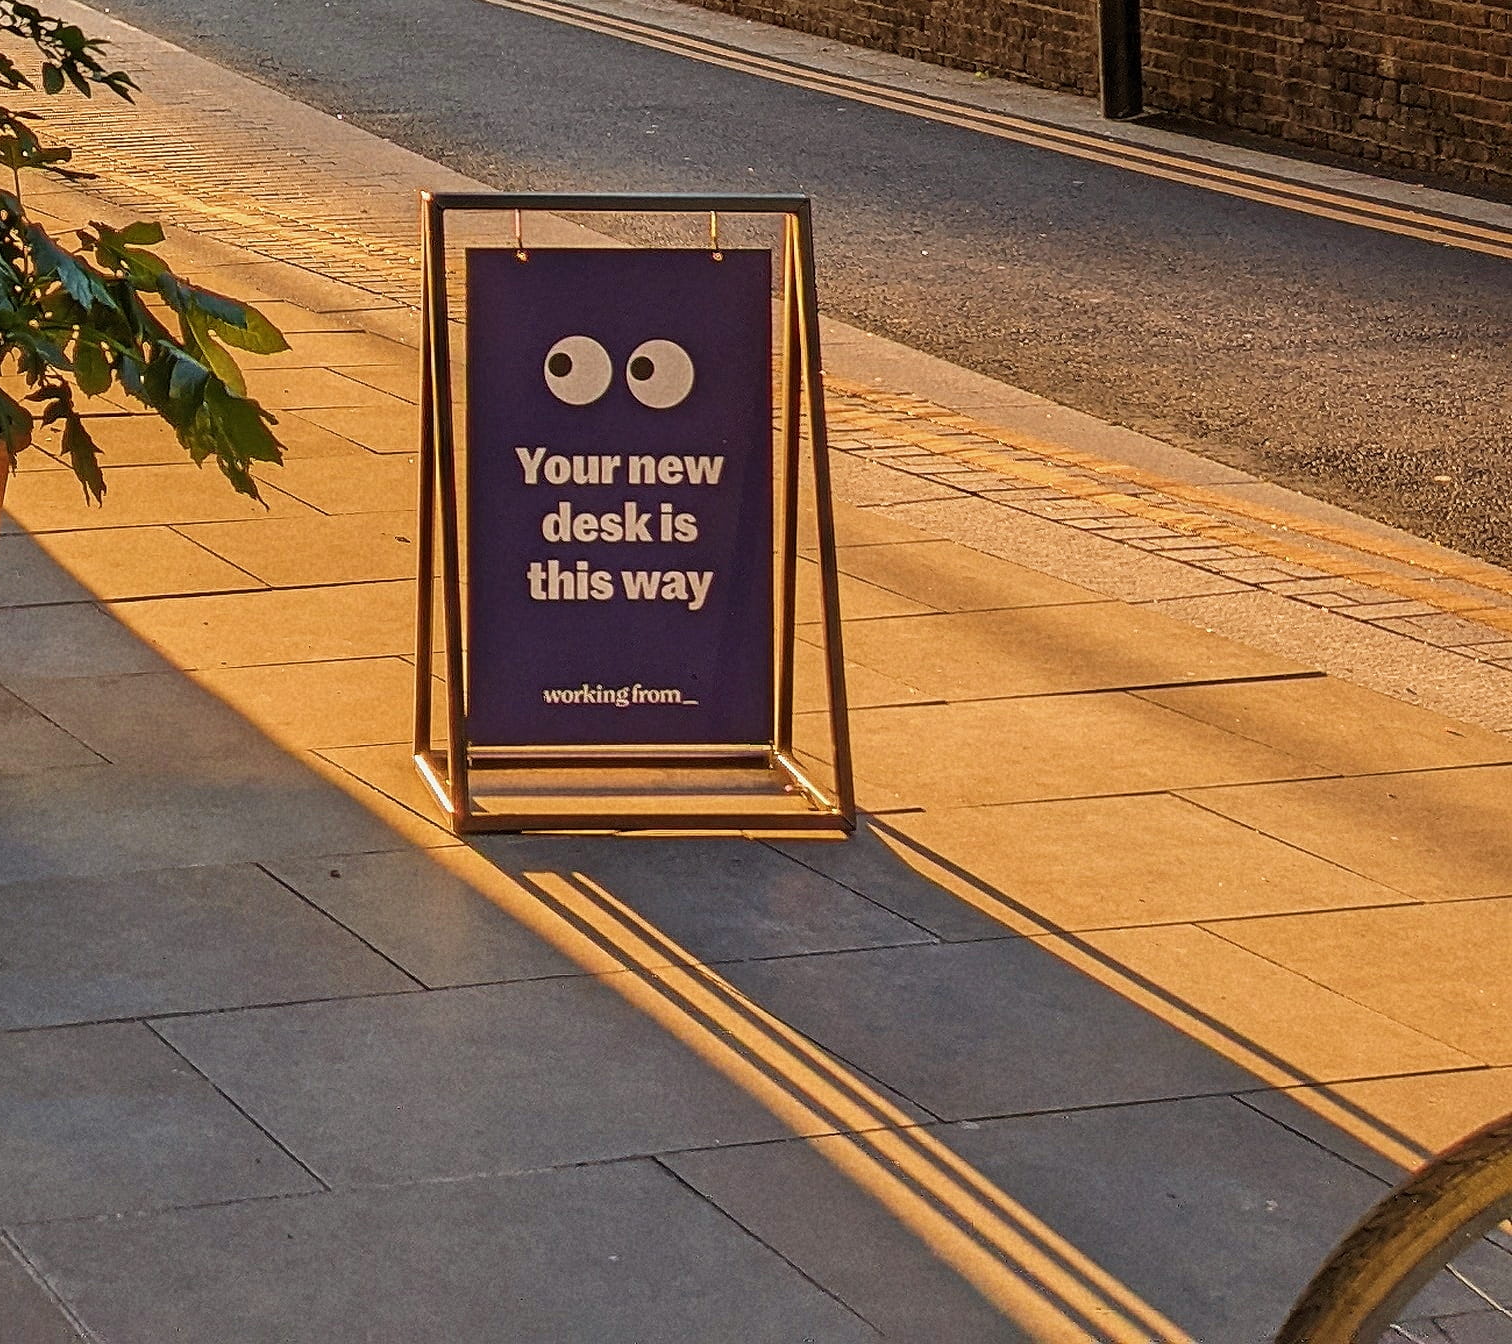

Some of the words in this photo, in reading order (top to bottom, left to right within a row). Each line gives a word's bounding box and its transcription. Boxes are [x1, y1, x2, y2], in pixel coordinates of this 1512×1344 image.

[514, 447, 621, 485] Your
[628, 455, 724, 485] new
[542, 501, 654, 543] desk
[660, 502, 698, 543] is
[526, 559, 614, 601] this
[620, 570, 714, 611] way
